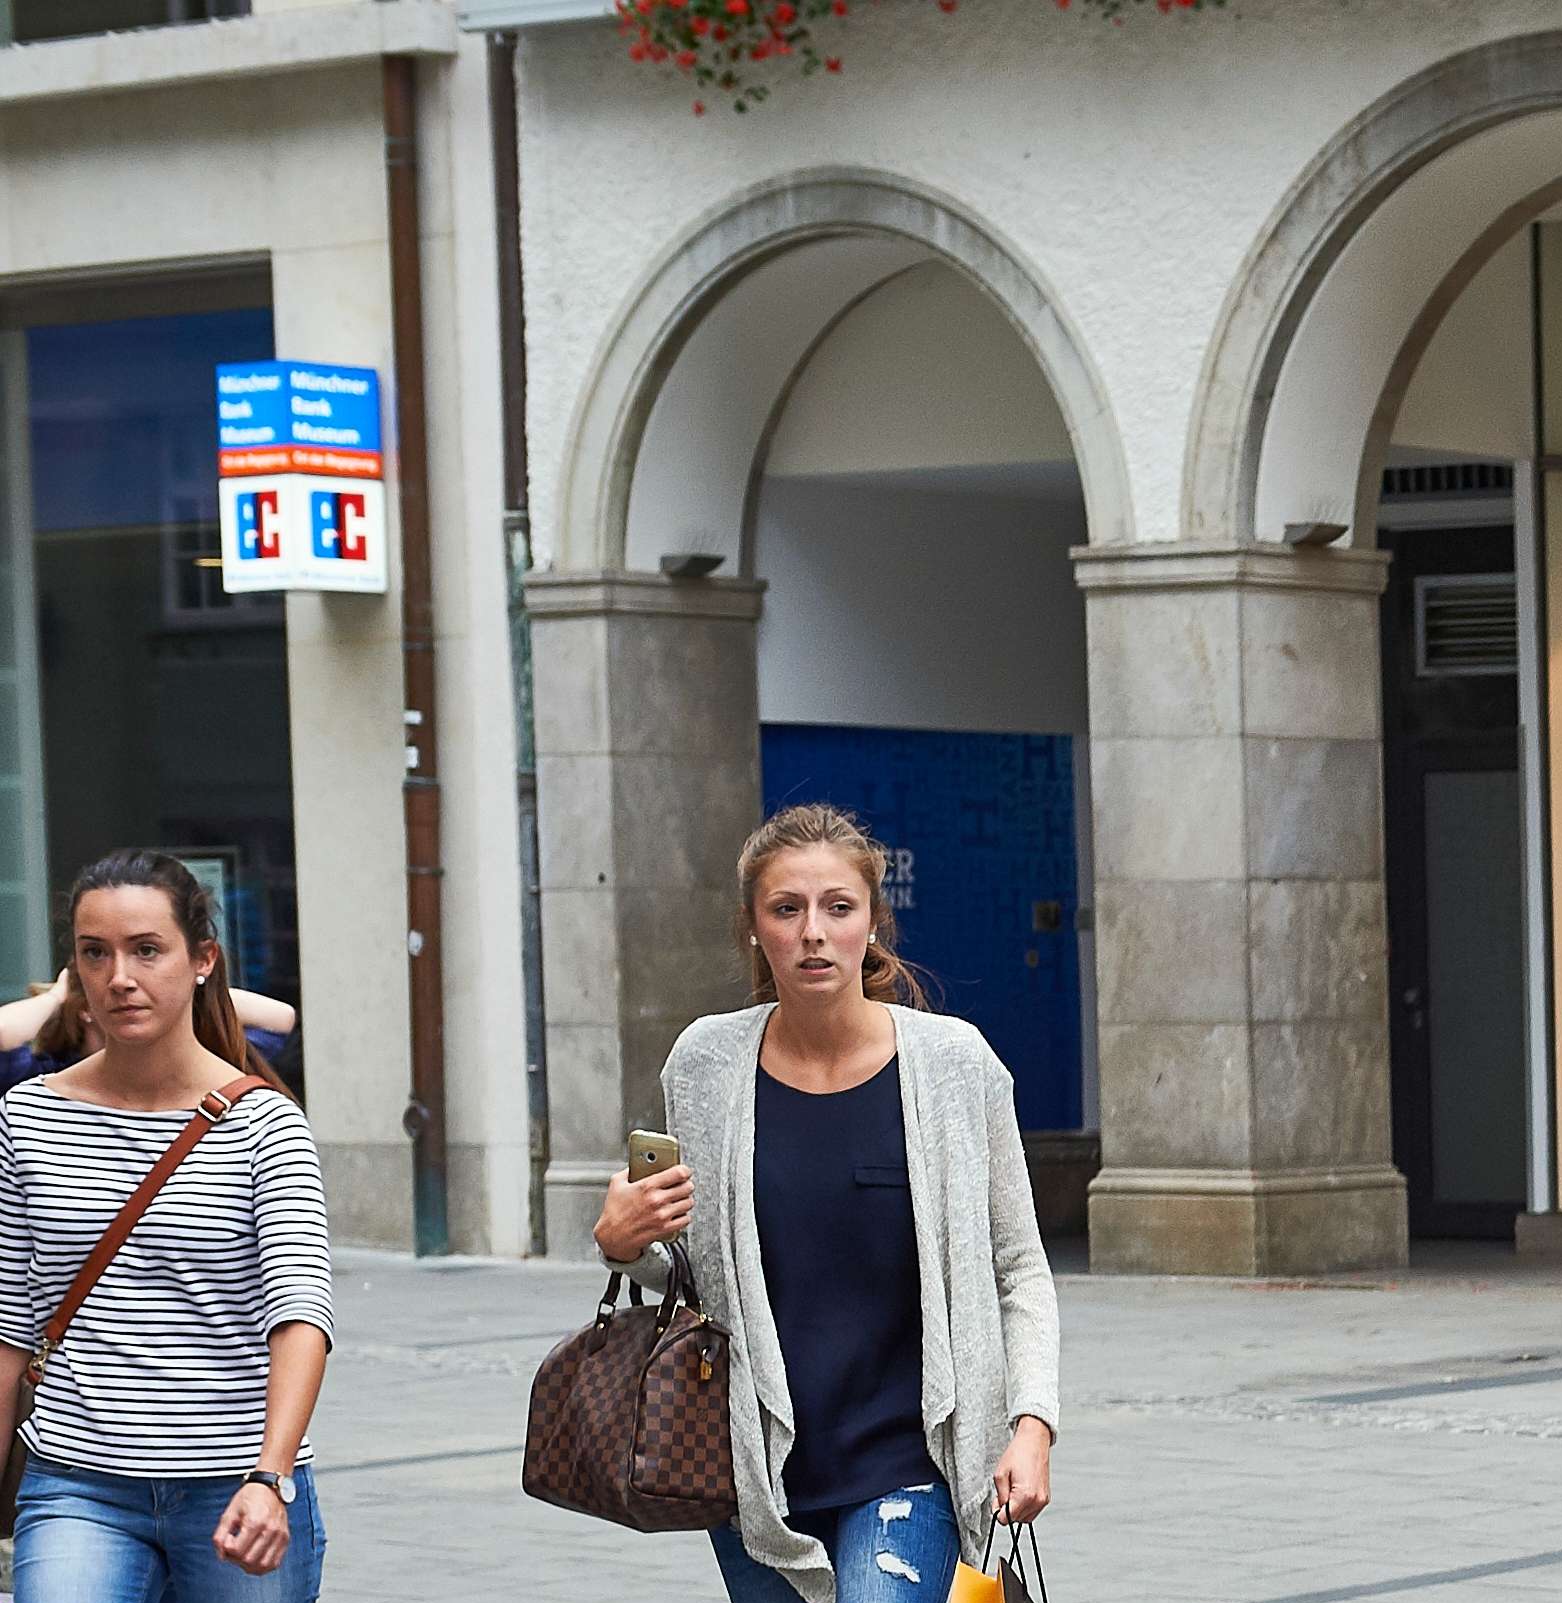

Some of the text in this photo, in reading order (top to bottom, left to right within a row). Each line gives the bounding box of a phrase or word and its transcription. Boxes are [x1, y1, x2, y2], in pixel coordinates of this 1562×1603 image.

[290, 370, 369, 396] Münchner
[291, 396, 332, 417] Bank
[292, 421, 360, 445] Museum
